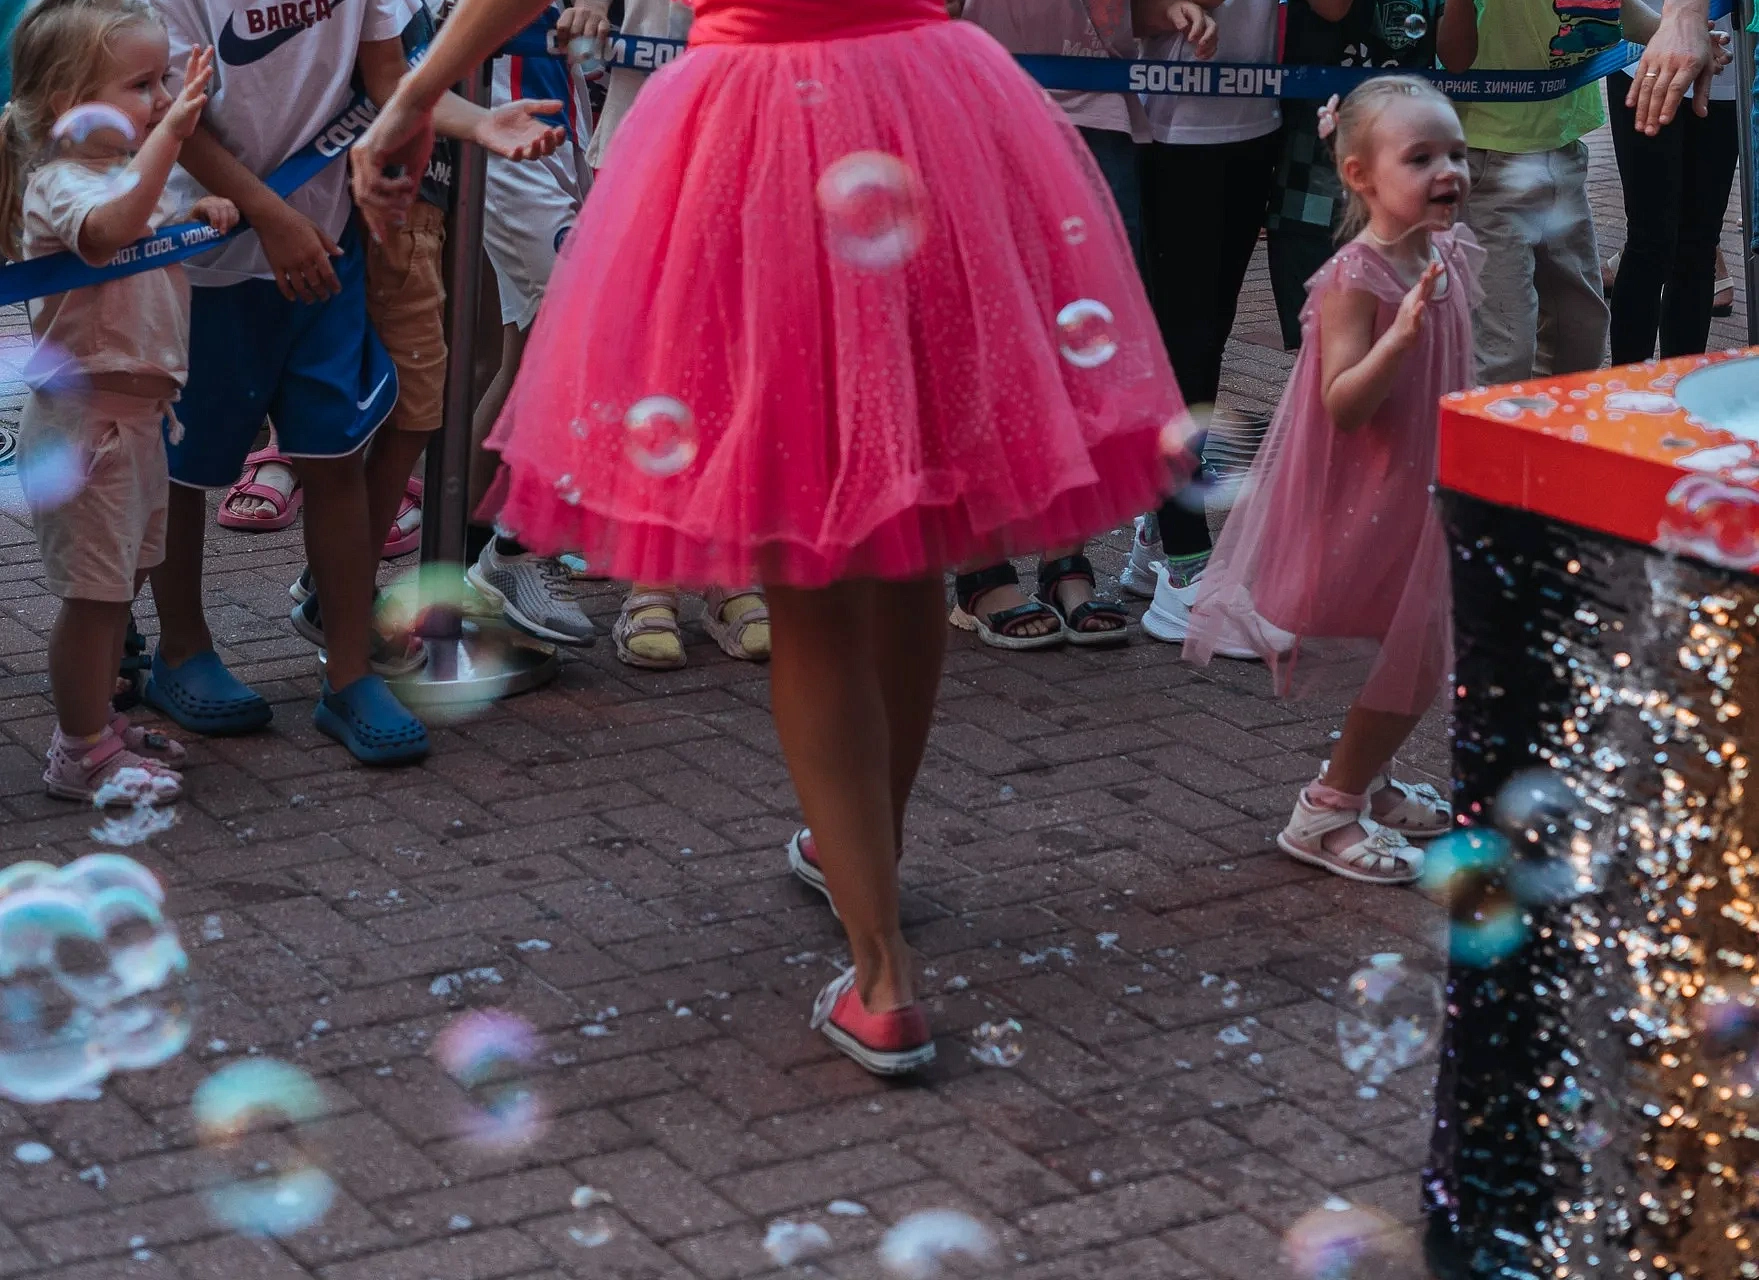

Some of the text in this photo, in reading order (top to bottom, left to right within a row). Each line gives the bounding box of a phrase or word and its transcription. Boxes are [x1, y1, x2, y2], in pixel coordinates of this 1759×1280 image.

[1129, 64, 1282, 95] SOCHI 2014
[1484, 81, 1537, 94] ЗИМНИЕ.
[144, 236, 179, 257] COOL.
